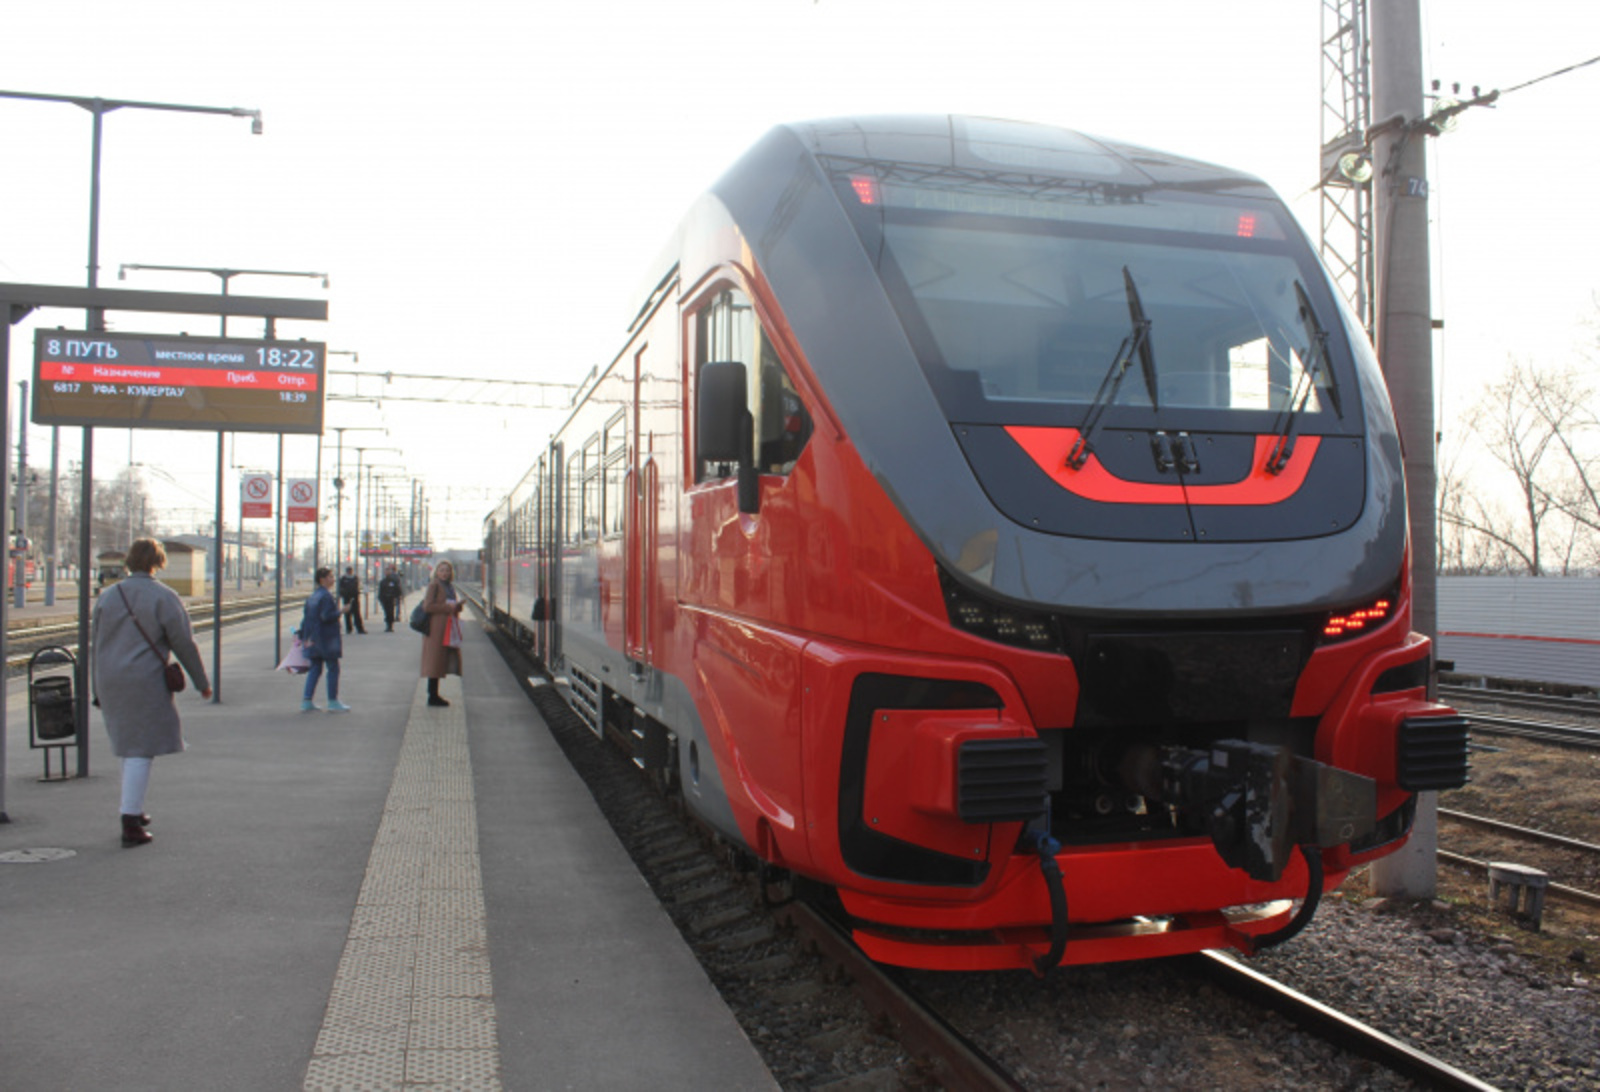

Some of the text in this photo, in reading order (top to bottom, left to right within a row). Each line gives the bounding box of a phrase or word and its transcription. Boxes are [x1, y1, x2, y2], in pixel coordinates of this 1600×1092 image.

[47, 339, 119, 359] 8 ПУТЬ
[155, 350, 245, 364] местное время
[256, 347, 315, 368] 18:22
[93, 366, 161, 379] Назначение
[227, 371, 259, 384] Приб.
[277, 374, 308, 387] Отпр.
[53, 382, 81, 393] 6817
[92, 384, 118, 395] УФА
[127, 386, 185, 397] КУМЕРТАУ
[279, 391, 307, 403] 18:39
